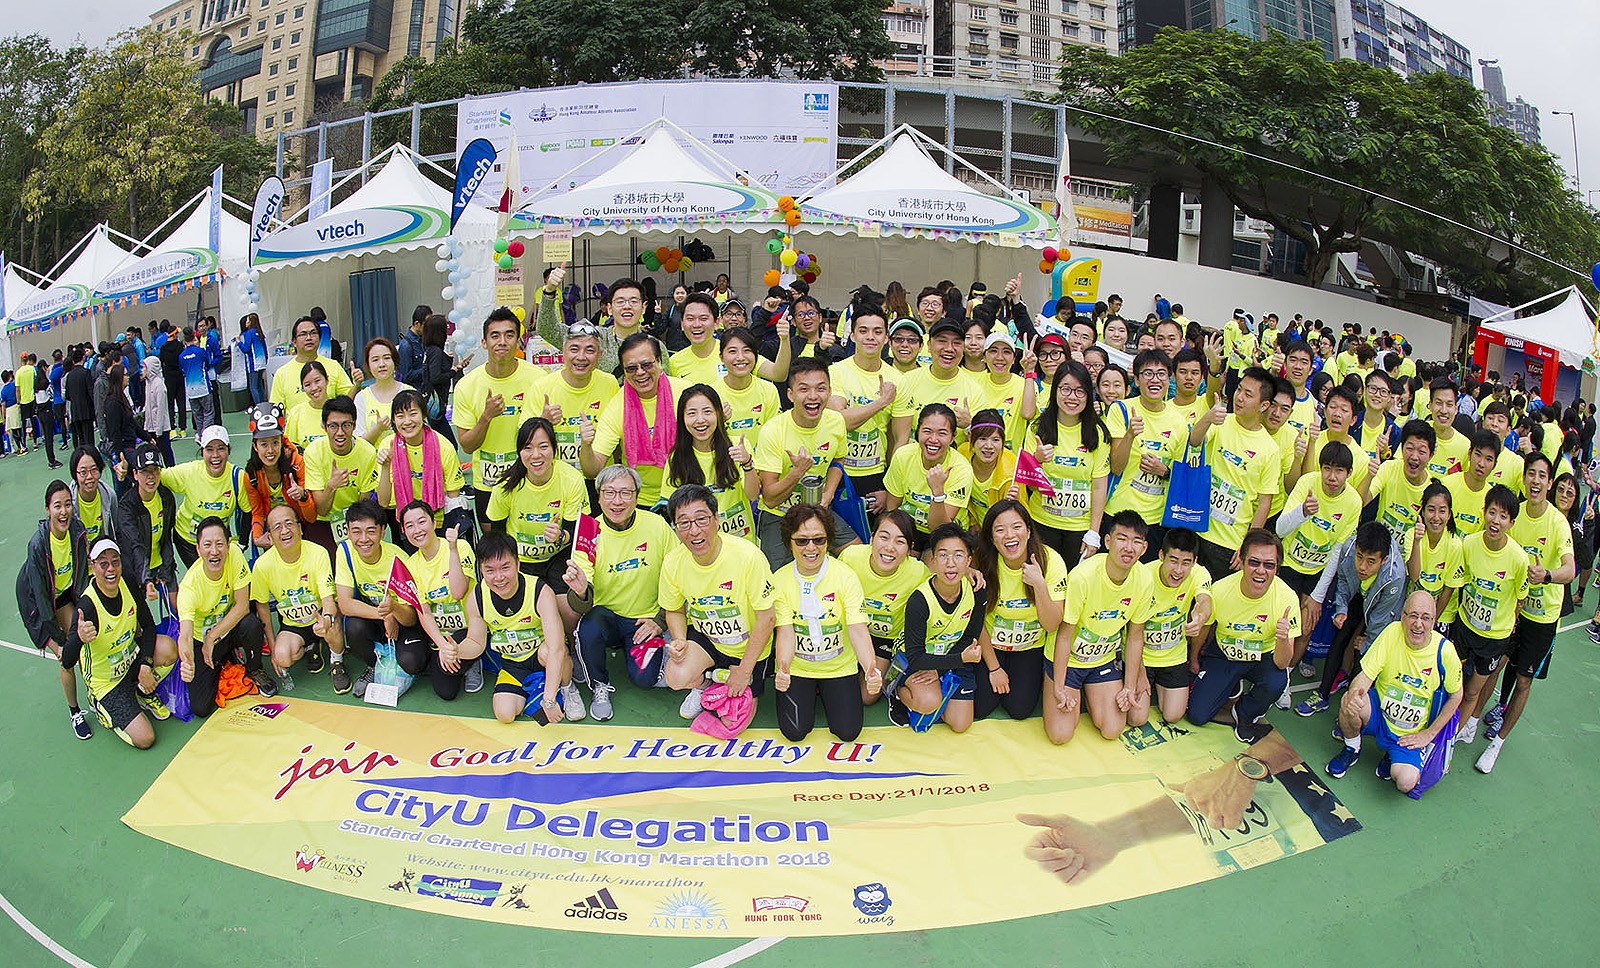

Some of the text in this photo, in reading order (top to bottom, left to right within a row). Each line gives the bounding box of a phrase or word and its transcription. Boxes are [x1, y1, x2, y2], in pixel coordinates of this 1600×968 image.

[466, 116, 497, 125] Chartered
[469, 109, 497, 118] Standard
[455, 156, 492, 210] vtech
[613, 191, 685, 205] 香港城市大學
[898, 197, 967, 213] 香港城市大學
[252, 192, 281, 244] vtech
[582, 204, 716, 217] City University of Hong Kong
[867, 208, 995, 227] City University of Hong Kong
[317, 219, 364, 242] vtech
[1100, 220, 1129, 230] Meditation
[1504, 337, 1524, 348] FINISH
[1210, 488, 1237, 514] 3813
[336, 524, 349, 538] 65
[1292, 545, 1328, 564] K3722
[1464, 597, 1491, 623] K3738
[697, 618, 742, 635] K2694
[796, 634, 839, 652] K324
[996, 631, 1039, 644] G1927
[1146, 627, 1184, 643] K3784
[1385, 701, 1421, 722] K3726
[429, 737, 882, 768] Goal for Healthy U!
[274, 741, 399, 800] join
[792, 792, 843, 803] Race
[355, 788, 830, 847] CityU Delegation
[340, 819, 830, 867] Standard Chartered Hong Kong Marathon 2018
[408, 853, 705, 887] Website: www.cityu.edu.hk/marathon
[430, 879, 471, 890] CityU
[564, 906, 628, 921] adidas
[745, 914, 768, 922] HUNG
[773, 914, 794, 922] FOOK
[857, 914, 895, 927] waiz
[649, 917, 729, 930] ANESSA
